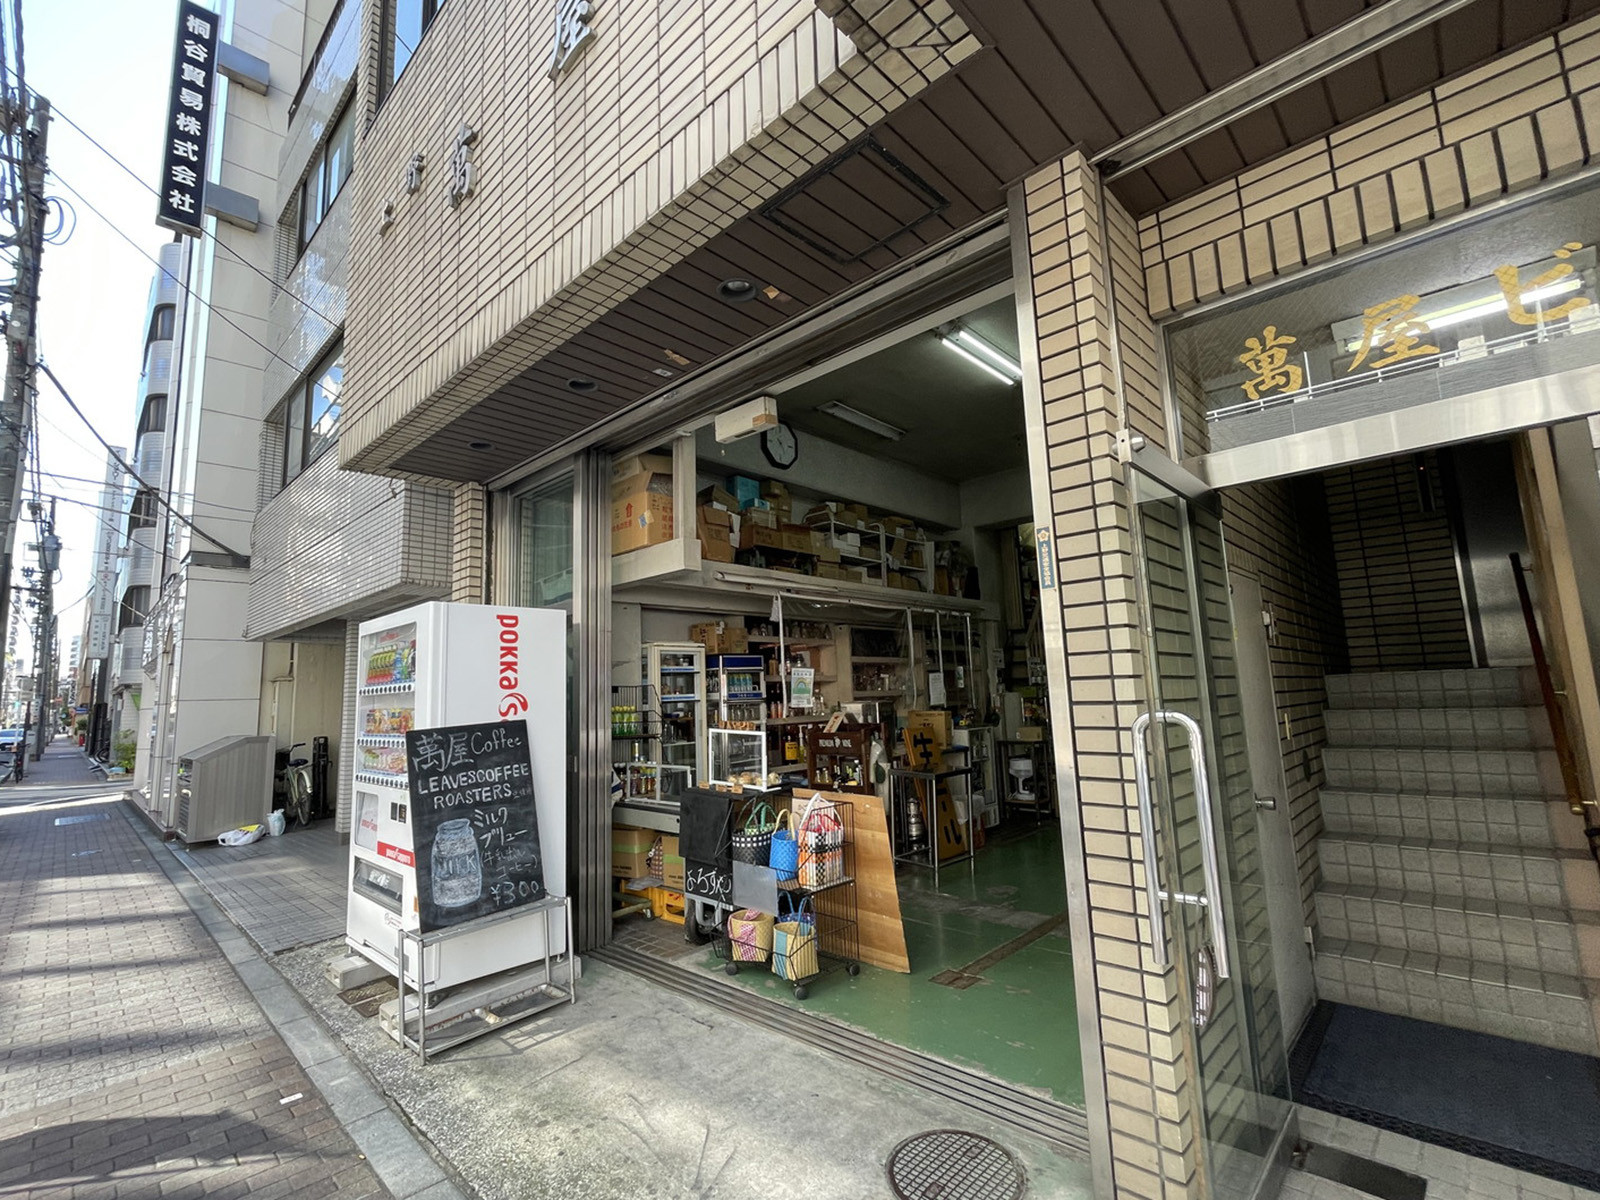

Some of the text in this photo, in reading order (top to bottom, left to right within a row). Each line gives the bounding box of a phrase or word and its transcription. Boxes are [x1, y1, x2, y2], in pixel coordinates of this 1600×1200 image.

[168, 14, 212, 214] 桐谷貿易株式会社
[470, 727, 522, 755] Coffee
[433, 783, 512, 810] ROASTERS
[473, 806, 508, 828] ミルク
[478, 826, 528, 848] ブリュー
[490, 880, 540, 906] ¥300
